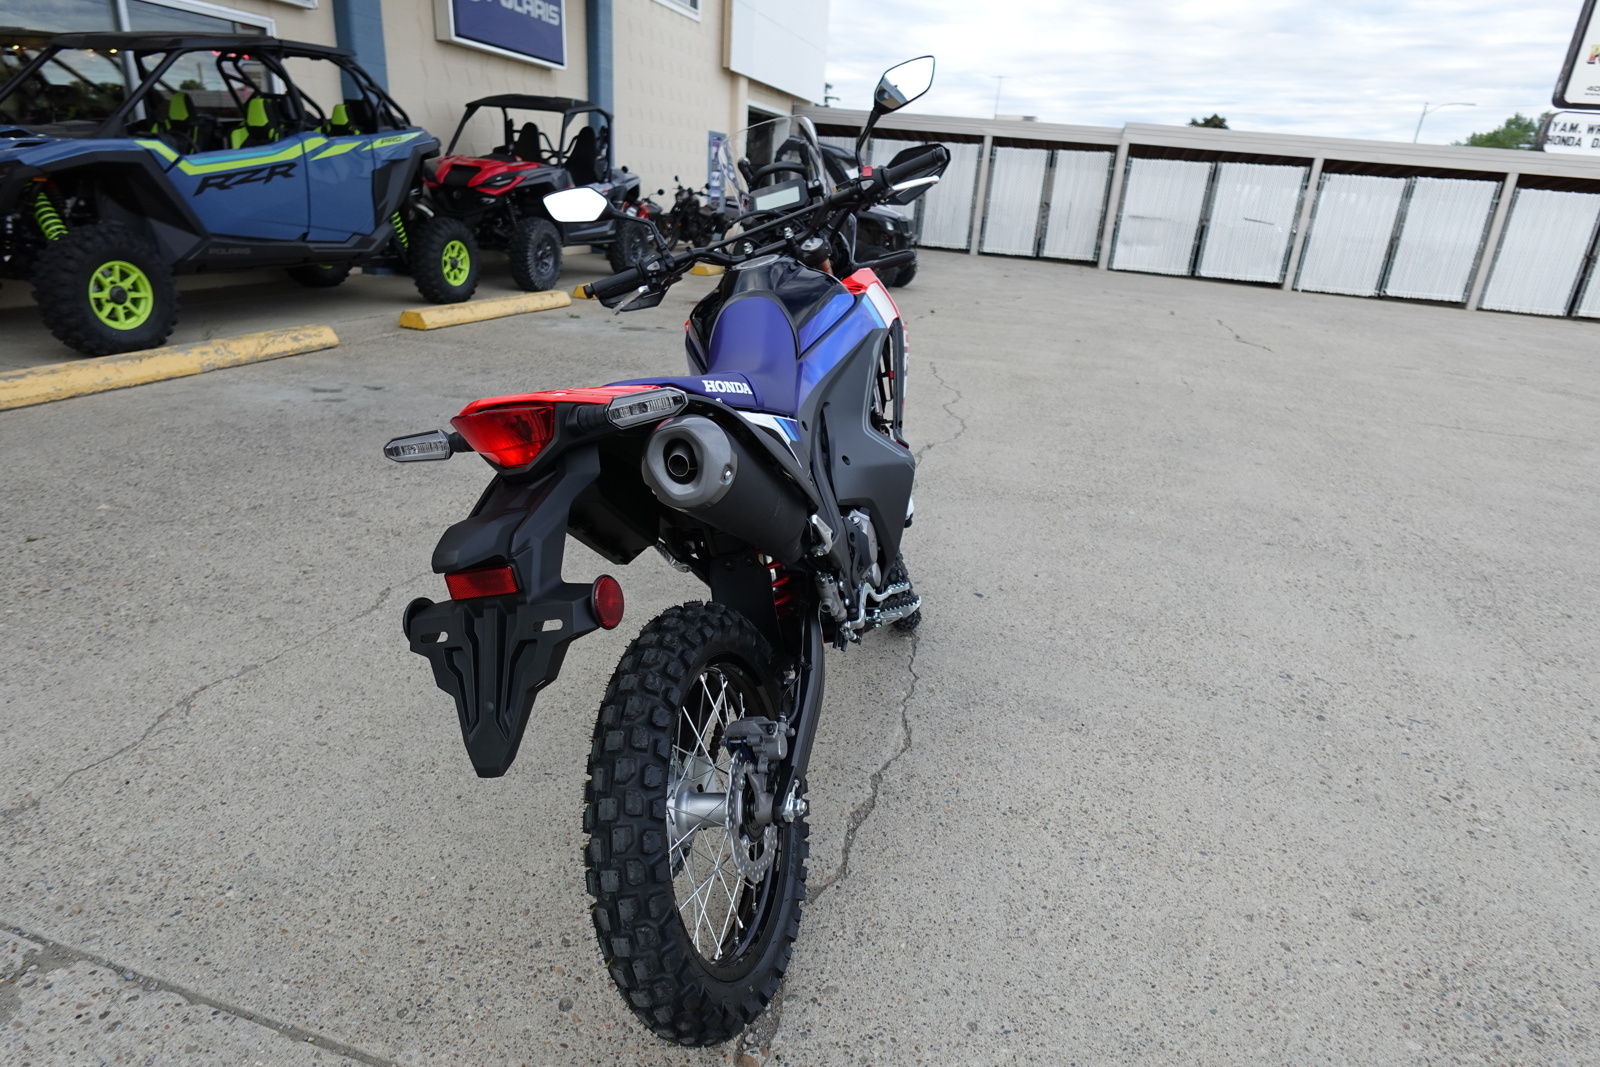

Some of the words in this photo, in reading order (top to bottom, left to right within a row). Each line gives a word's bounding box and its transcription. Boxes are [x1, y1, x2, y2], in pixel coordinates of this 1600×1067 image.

[485, 0, 560, 26] OLARIS
[1552, 121, 1582, 133] YAM.
[1547, 135, 1582, 147] HONDA
[193, 162, 297, 197] RZR
[702, 380, 753, 395] HONDA
